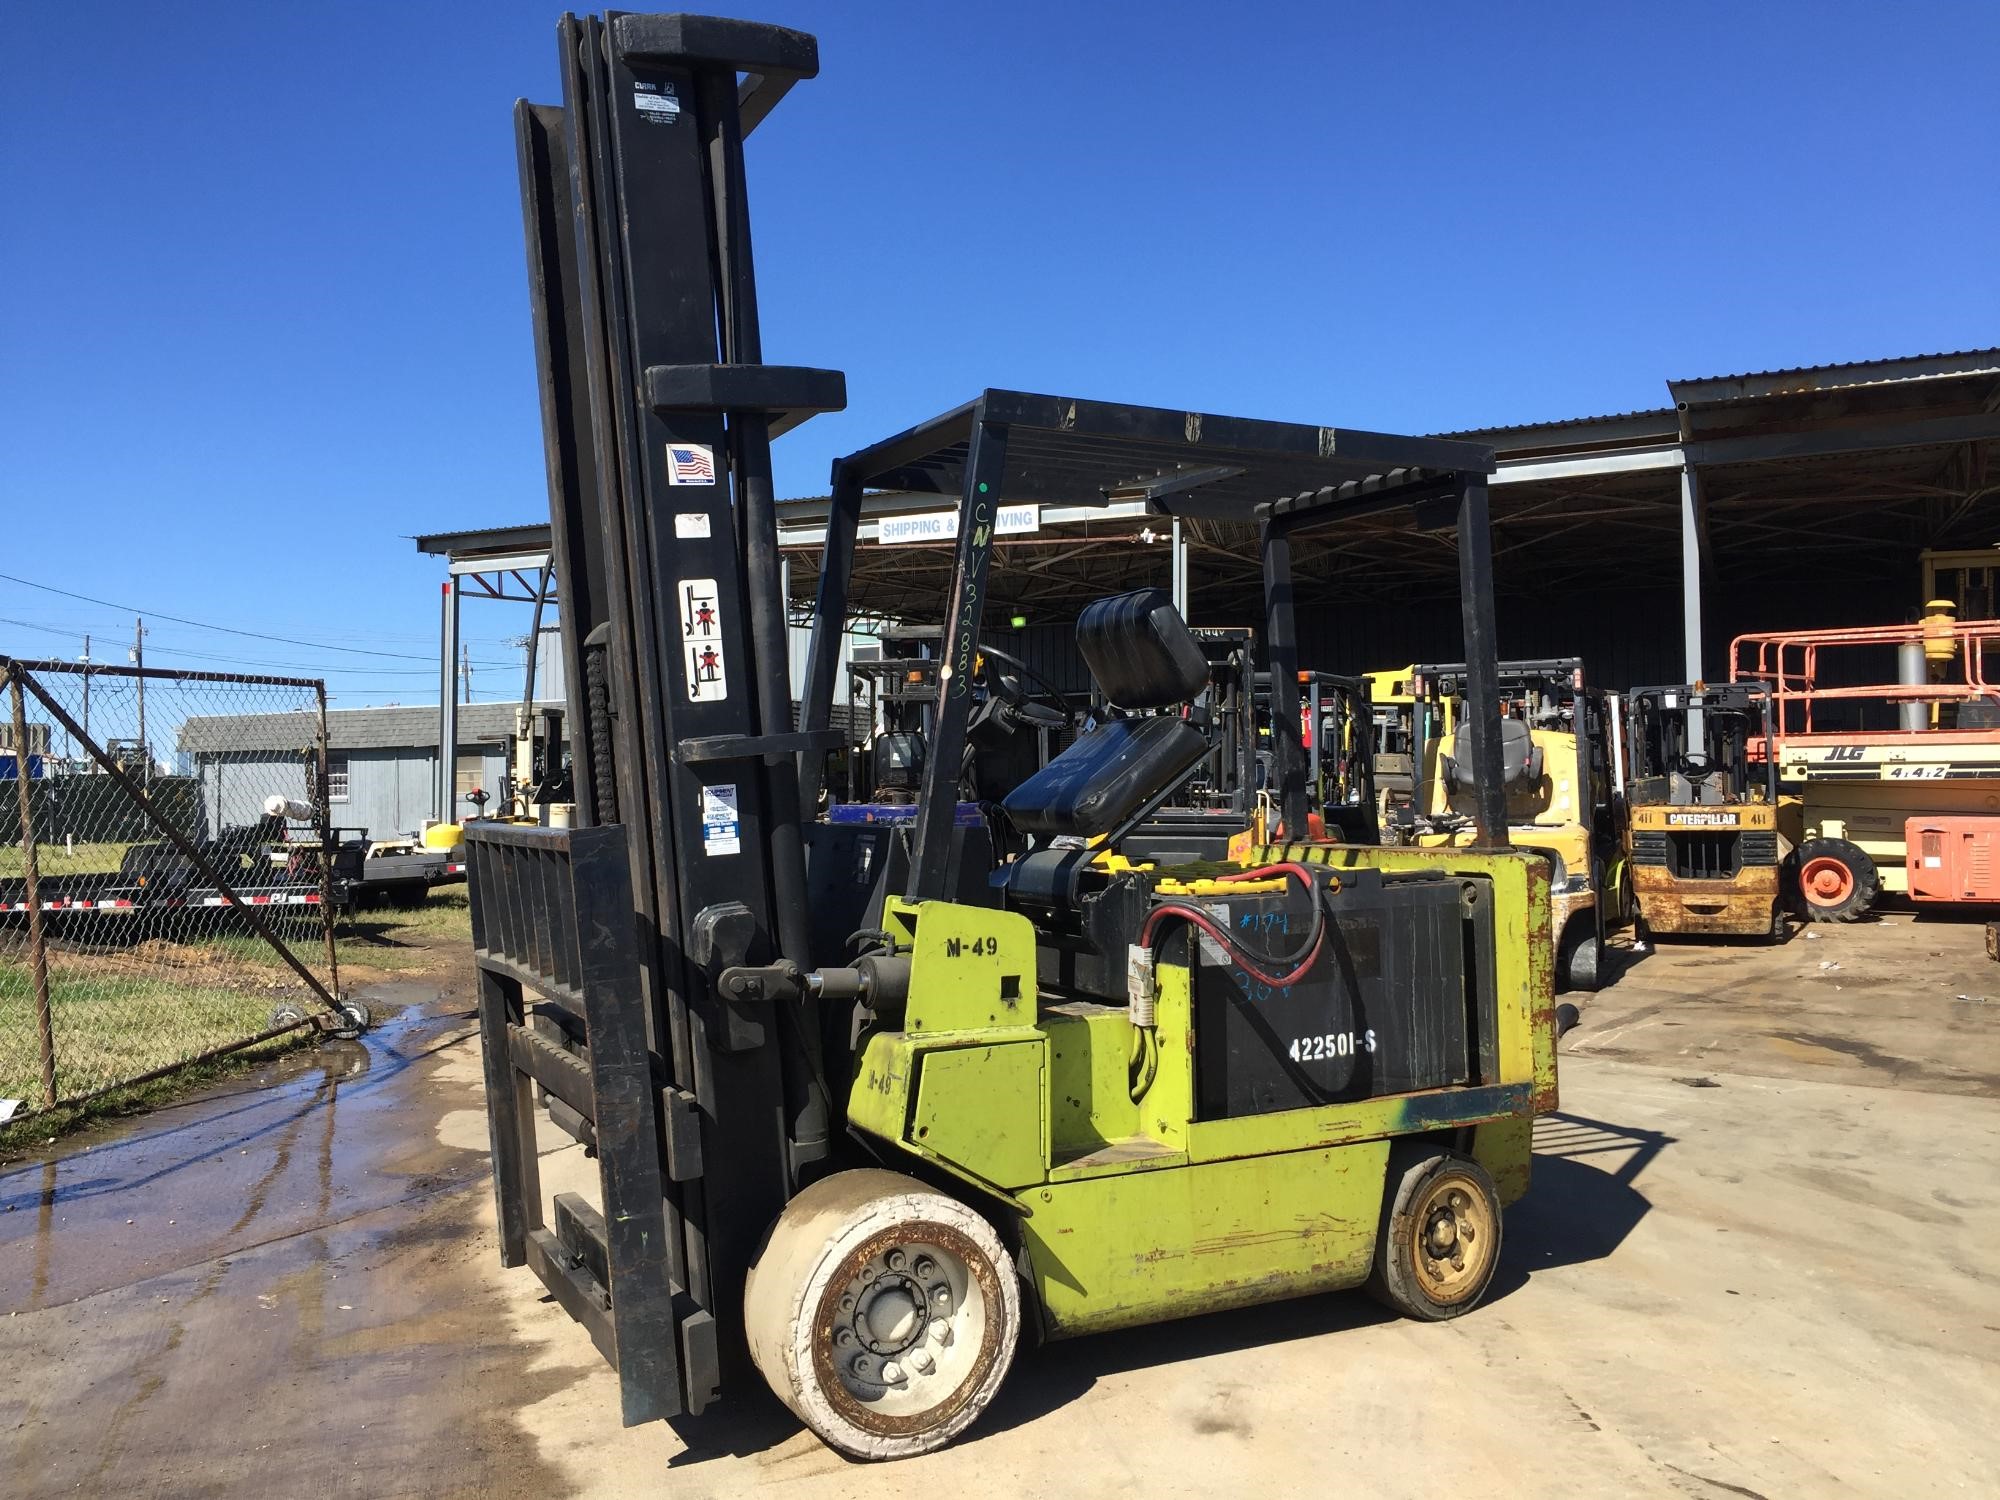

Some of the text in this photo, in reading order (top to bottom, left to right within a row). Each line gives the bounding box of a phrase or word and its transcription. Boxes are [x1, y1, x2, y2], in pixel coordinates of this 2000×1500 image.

[634, 81, 657, 90] CLARK
[883, 518, 941, 538] SHIPPING
[946, 518, 955, 532] &
[1824, 745, 1867, 761] JLG
[1669, 813, 1736, 825] CATERPILLAR
[946, 936, 998, 958] M-49
